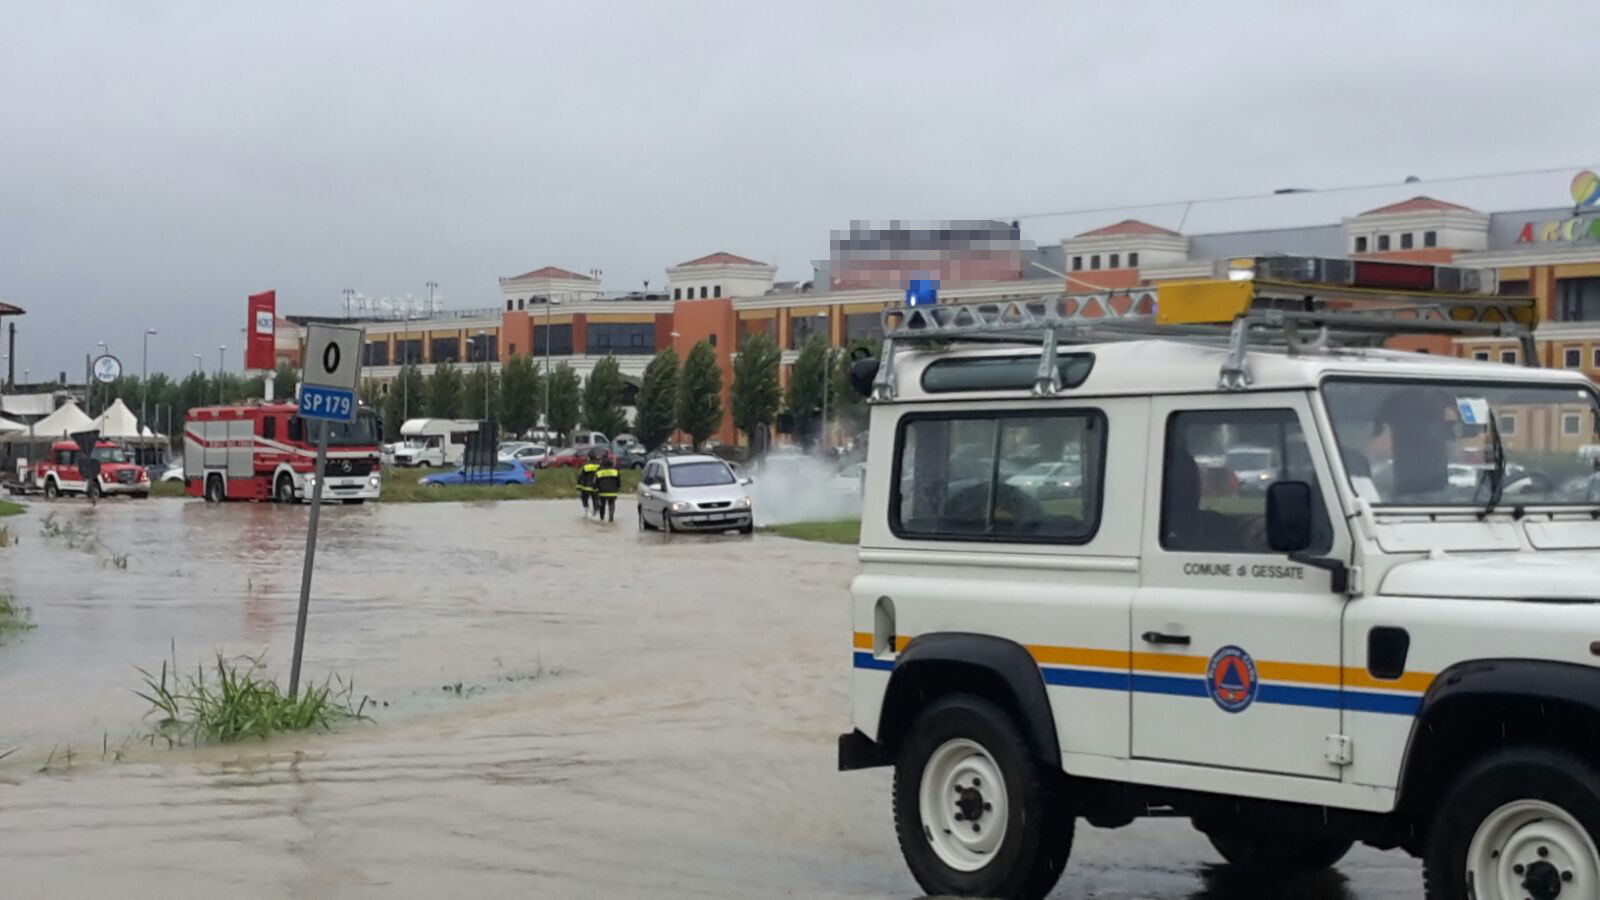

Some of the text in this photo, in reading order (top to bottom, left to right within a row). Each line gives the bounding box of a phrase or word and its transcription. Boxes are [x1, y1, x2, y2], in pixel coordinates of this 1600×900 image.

[323, 341, 341, 374] 0
[1183, 562, 1304, 579] COMUNE di GESSATE
